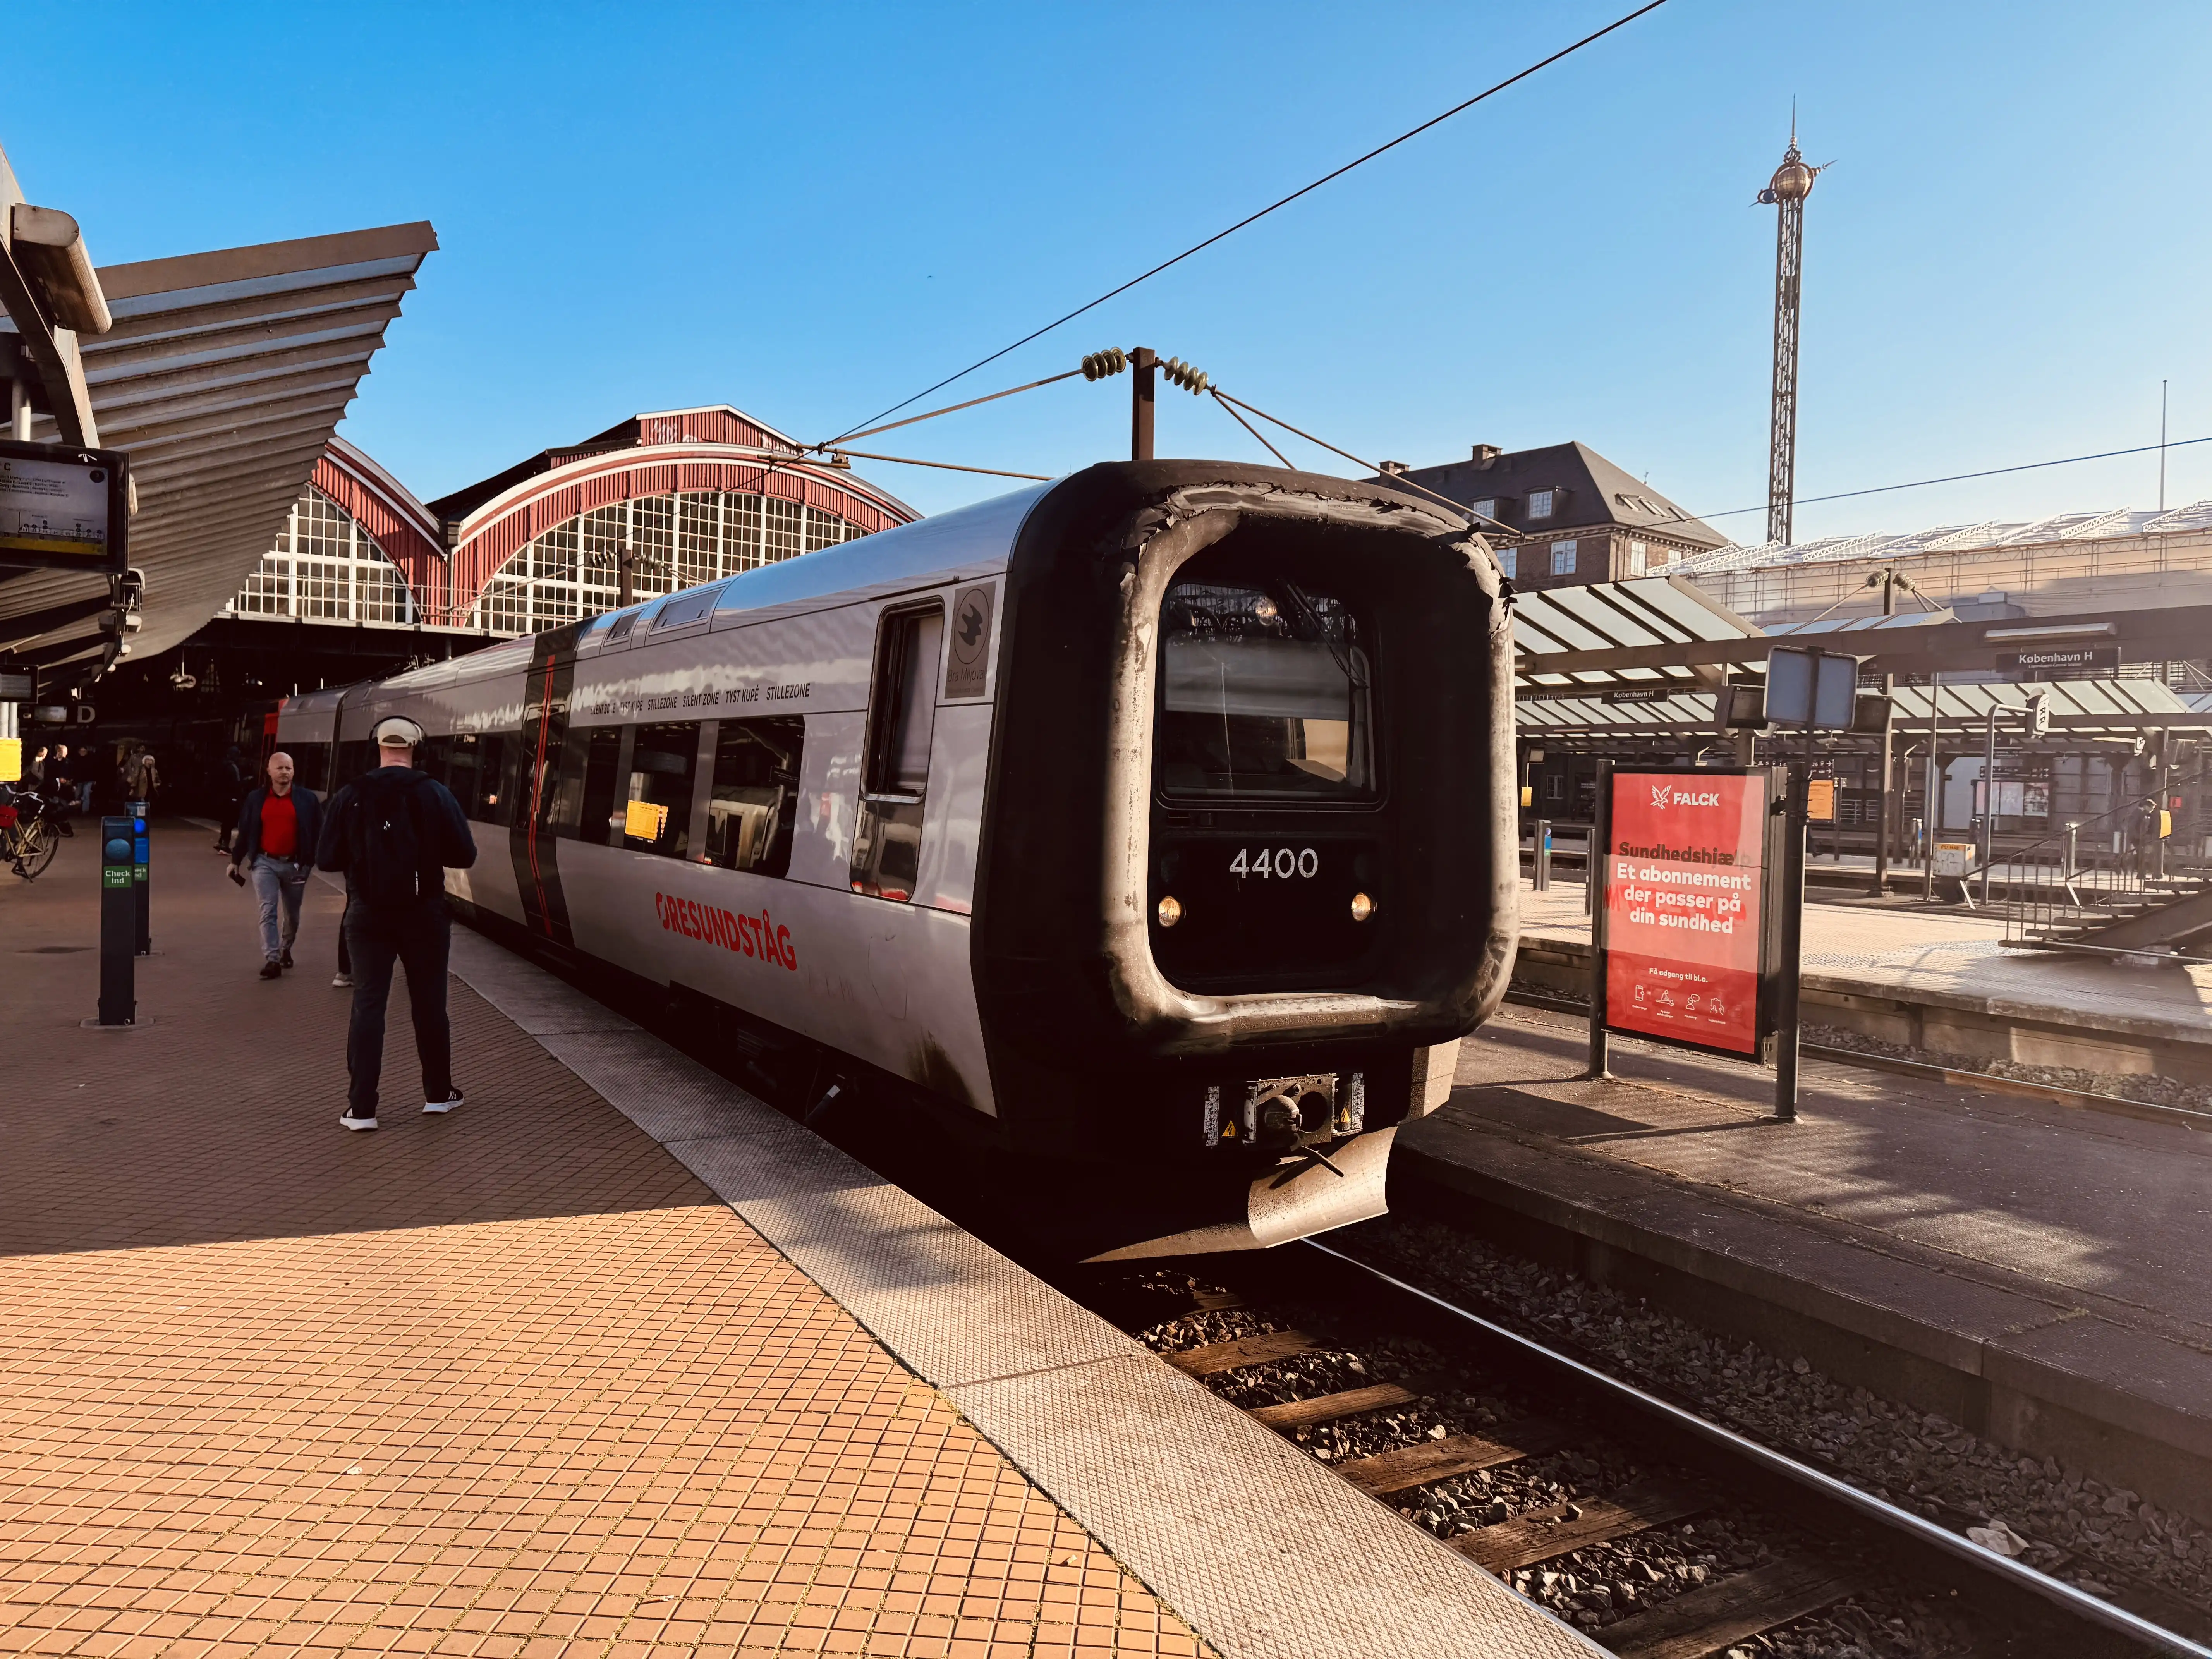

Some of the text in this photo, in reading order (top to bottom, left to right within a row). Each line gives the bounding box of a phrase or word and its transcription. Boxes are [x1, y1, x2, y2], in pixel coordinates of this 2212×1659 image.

[2019, 651, 2093, 664] København H
[947, 669, 959, 682] Bra
[648, 696, 677, 710] STILLEZONE
[682, 694, 702, 708] SILENT
[702, 692, 719, 706] ZONE
[726, 689, 741, 703] TYST
[742, 684, 759, 702] KUPÉ
[766, 682, 811, 701] STILLEZONE
[77, 705, 96, 723] D
[1673, 792, 1720, 806] FALCK
[1229, 848, 1318, 878] 4400
[1617, 862, 1752, 890] Et abonnement
[1624, 885, 1741, 914] der passer på
[1630, 906, 1733, 934] din sundhed
[1659, 970, 1684, 981] adgang
[1693, 974, 1708, 983] bl.a.
